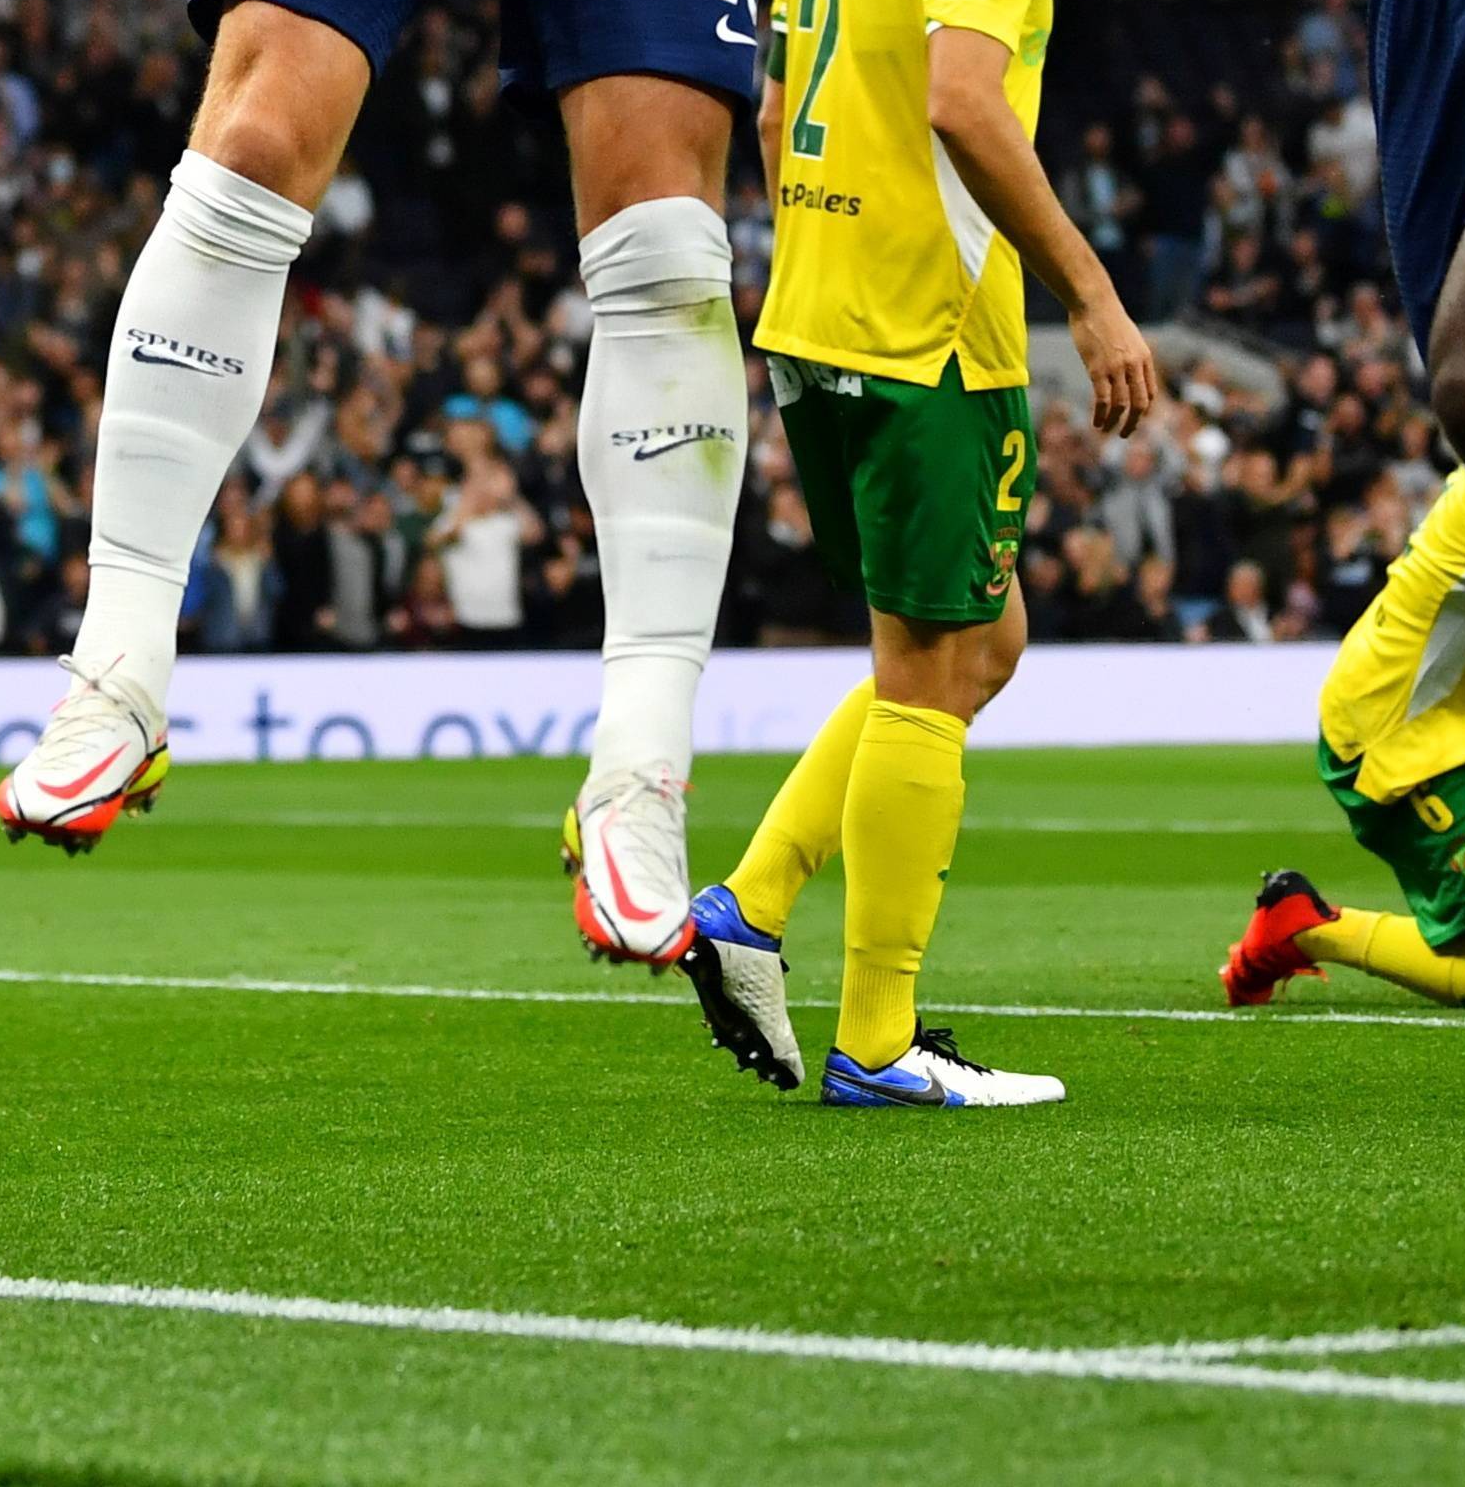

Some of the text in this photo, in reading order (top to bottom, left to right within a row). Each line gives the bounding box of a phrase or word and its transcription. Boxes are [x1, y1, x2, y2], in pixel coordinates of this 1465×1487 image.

[126, 328, 245, 375] SPURS
[611, 423, 736, 448] SPURS
[997, 428, 1026, 512] 2
